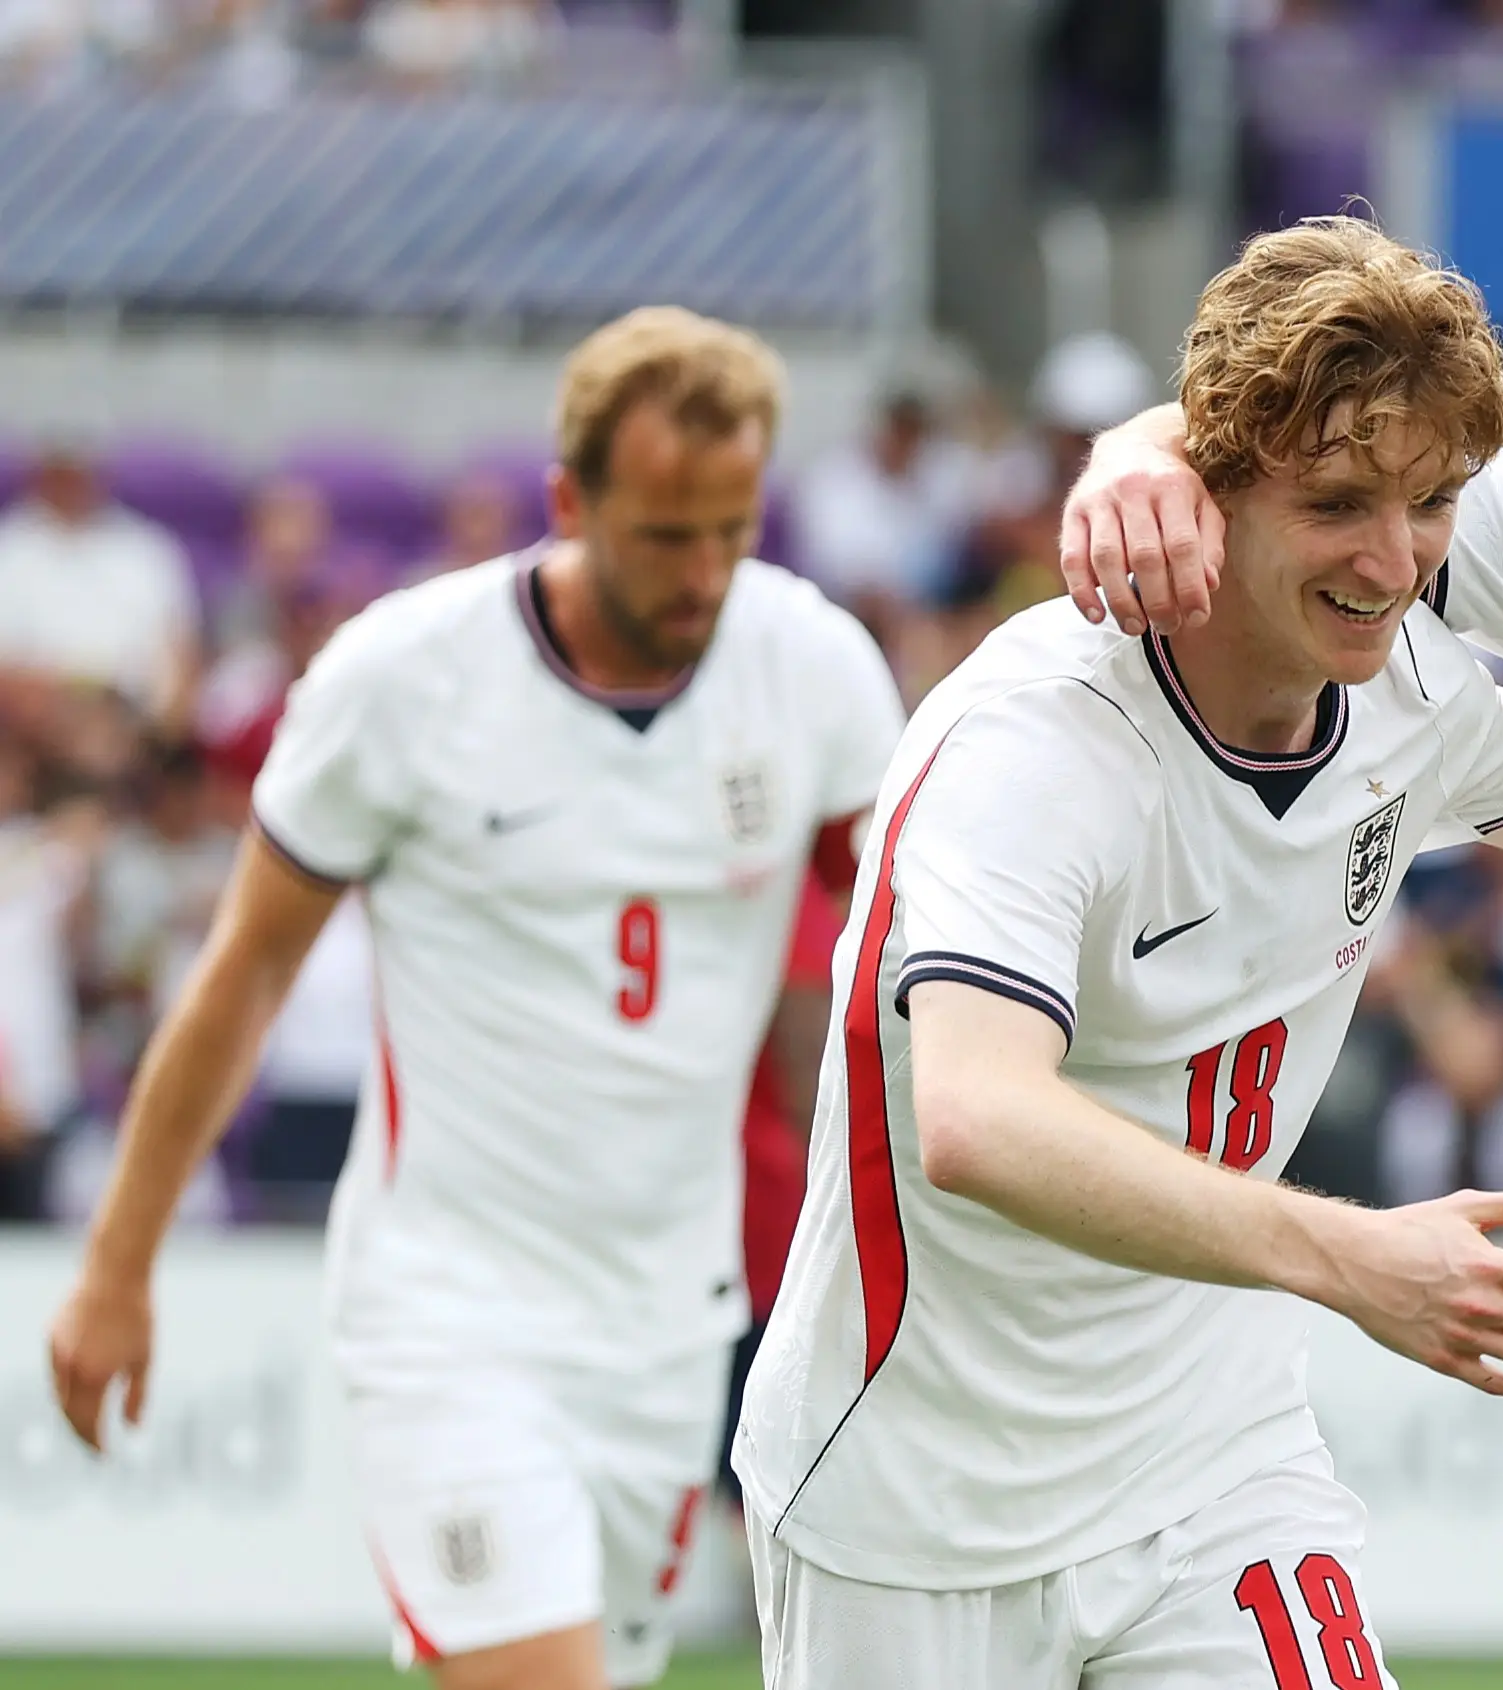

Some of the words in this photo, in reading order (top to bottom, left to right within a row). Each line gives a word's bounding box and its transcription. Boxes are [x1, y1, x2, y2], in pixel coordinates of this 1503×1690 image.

[616, 898, 659, 1023] 9
[1185, 1016, 1288, 1173] 18
[1233, 1553, 1384, 1690] 18
